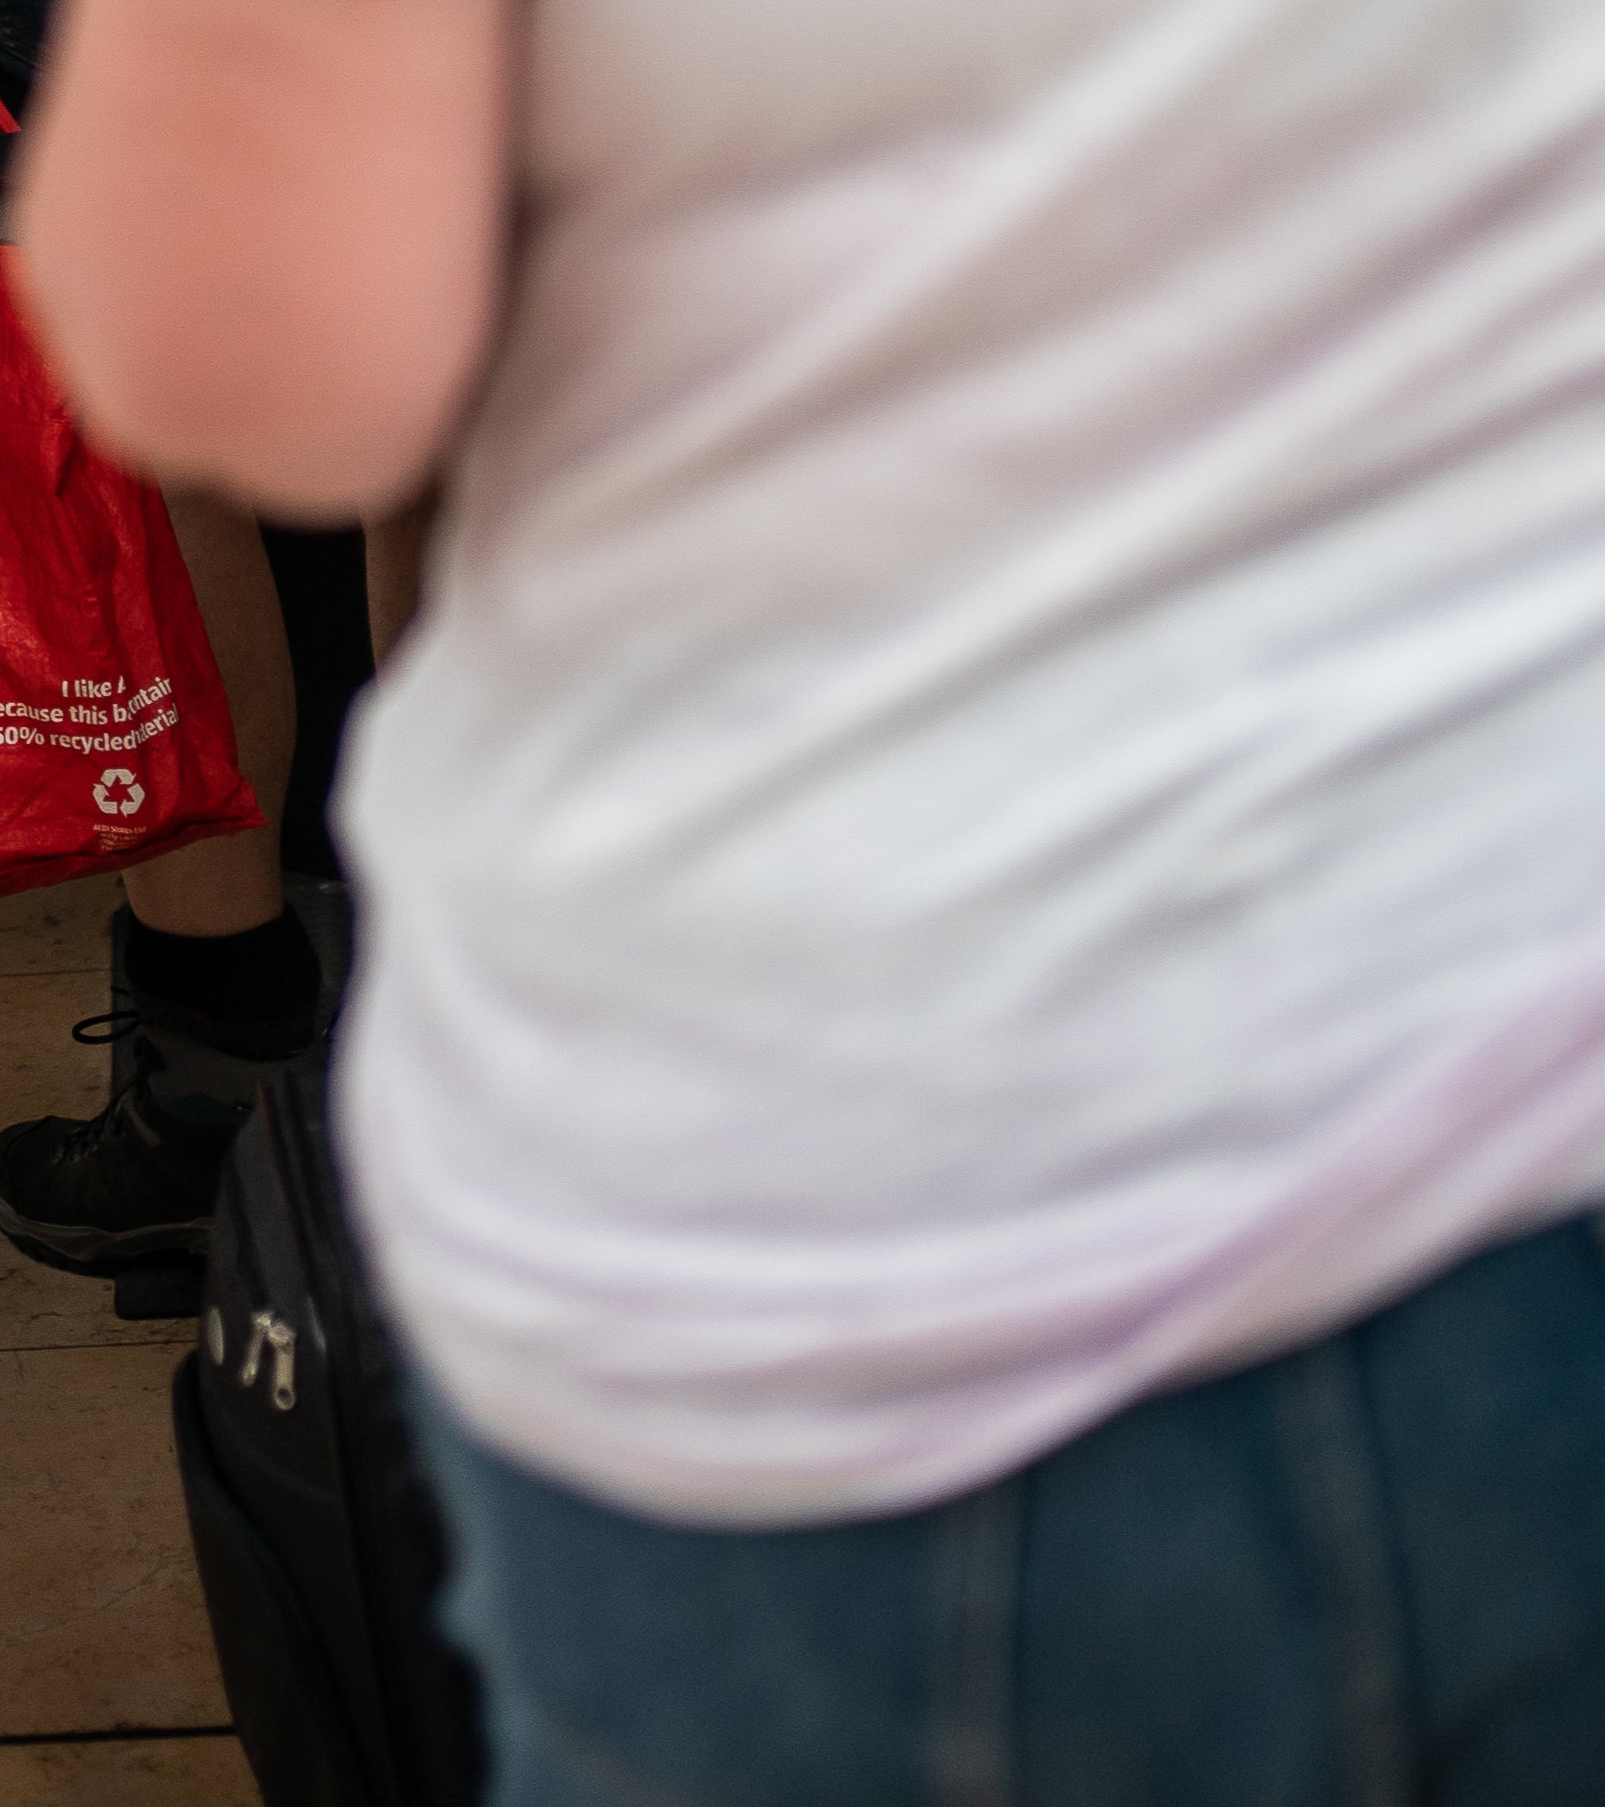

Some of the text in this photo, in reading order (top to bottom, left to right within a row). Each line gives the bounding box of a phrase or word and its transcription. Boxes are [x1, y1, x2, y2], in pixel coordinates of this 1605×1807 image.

[62, 680, 69, 697] I
[74, 679, 112, 698] like
[69, 705, 108, 725] this
[50, 729, 137, 754] recycled
